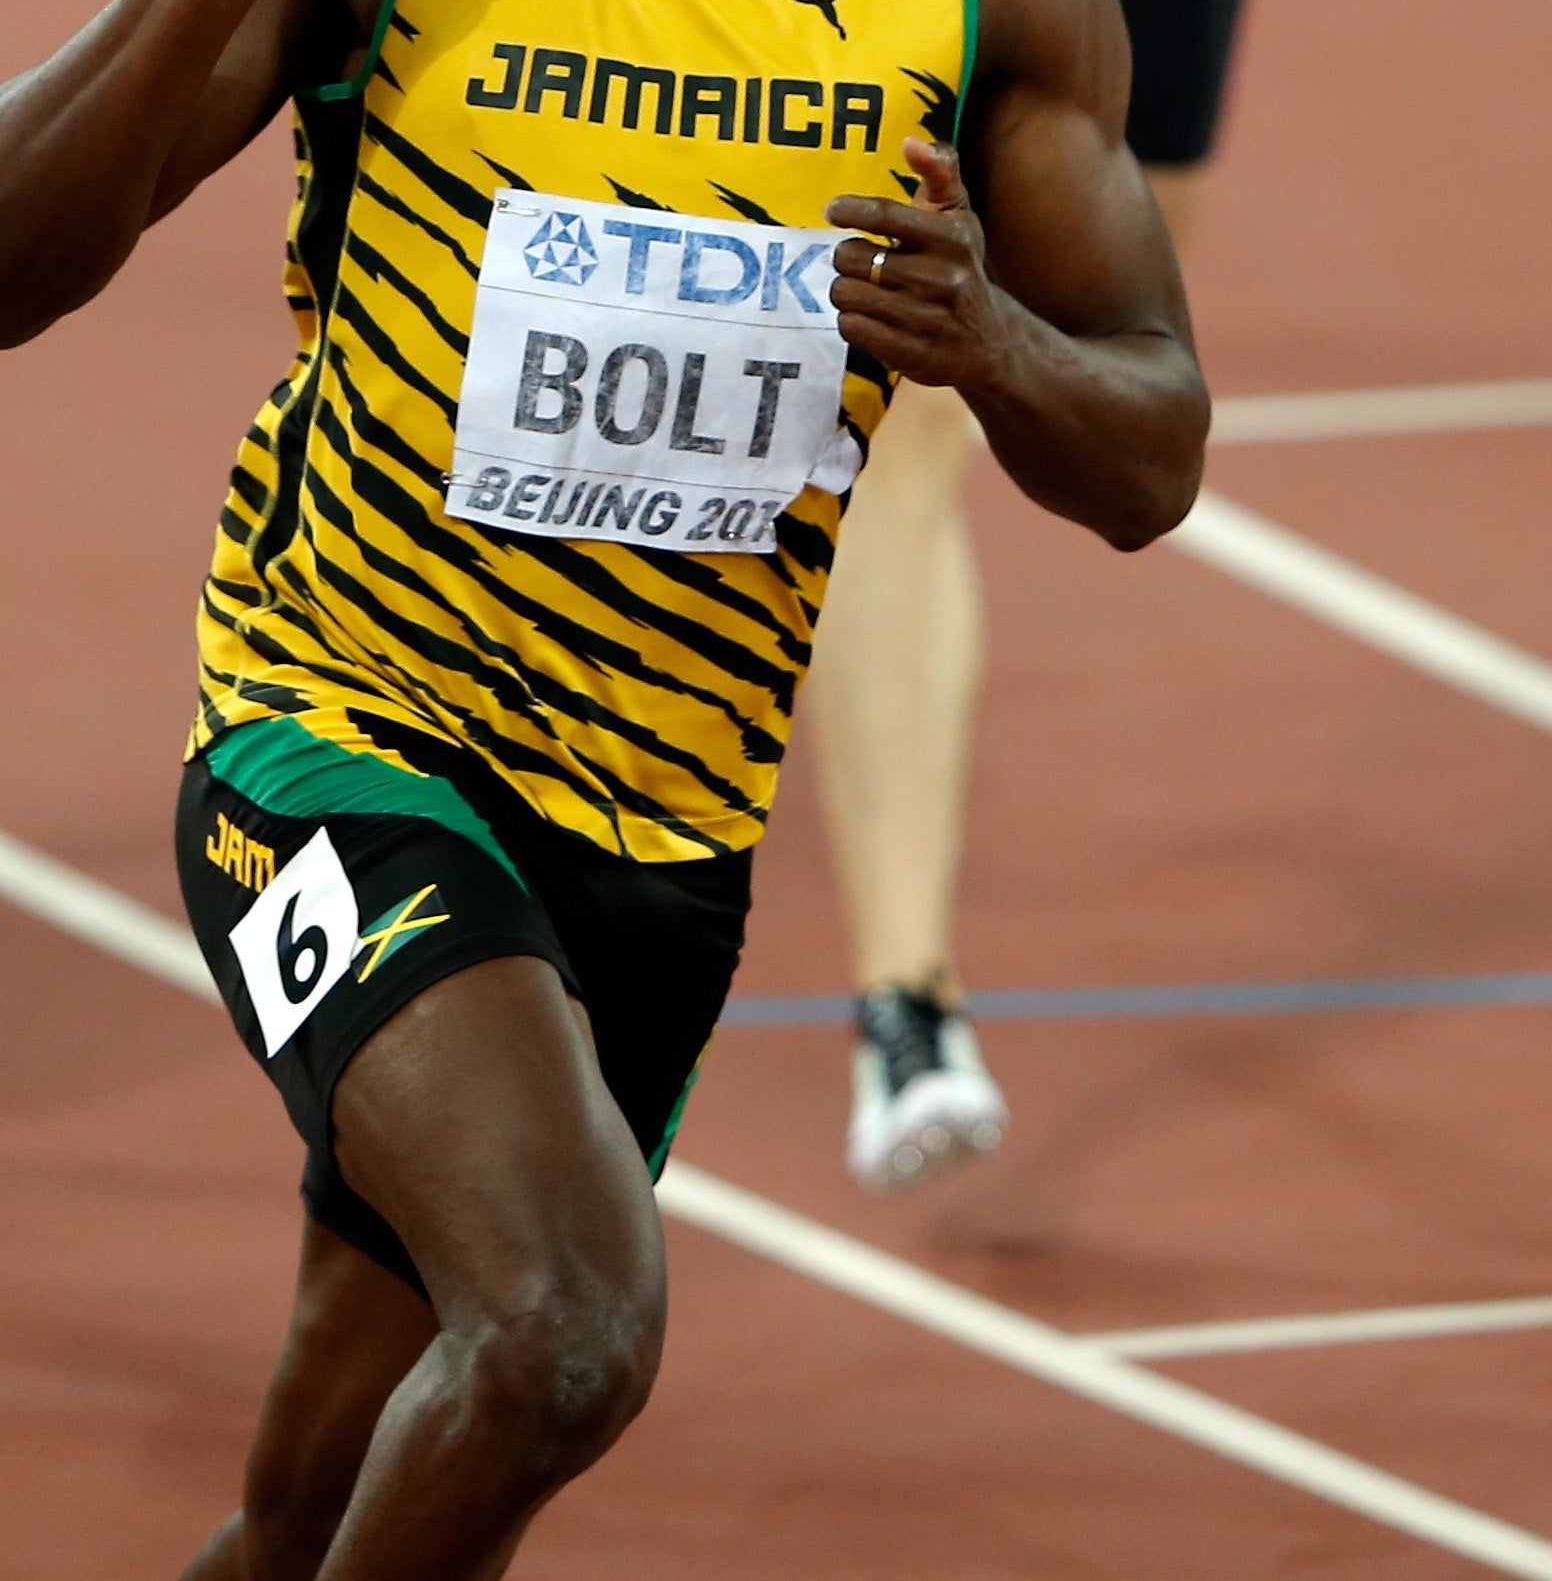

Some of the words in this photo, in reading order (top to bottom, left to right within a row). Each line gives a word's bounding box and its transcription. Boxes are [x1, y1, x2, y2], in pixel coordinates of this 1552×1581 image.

[465, 43, 885, 152] JAMAICA
[603, 220, 829, 314] TDK
[512, 330, 801, 460] BOLT
[464, 466, 684, 537] BEIJING
[684, 496, 778, 543] 201
[276, 888, 329, 1005] 6
